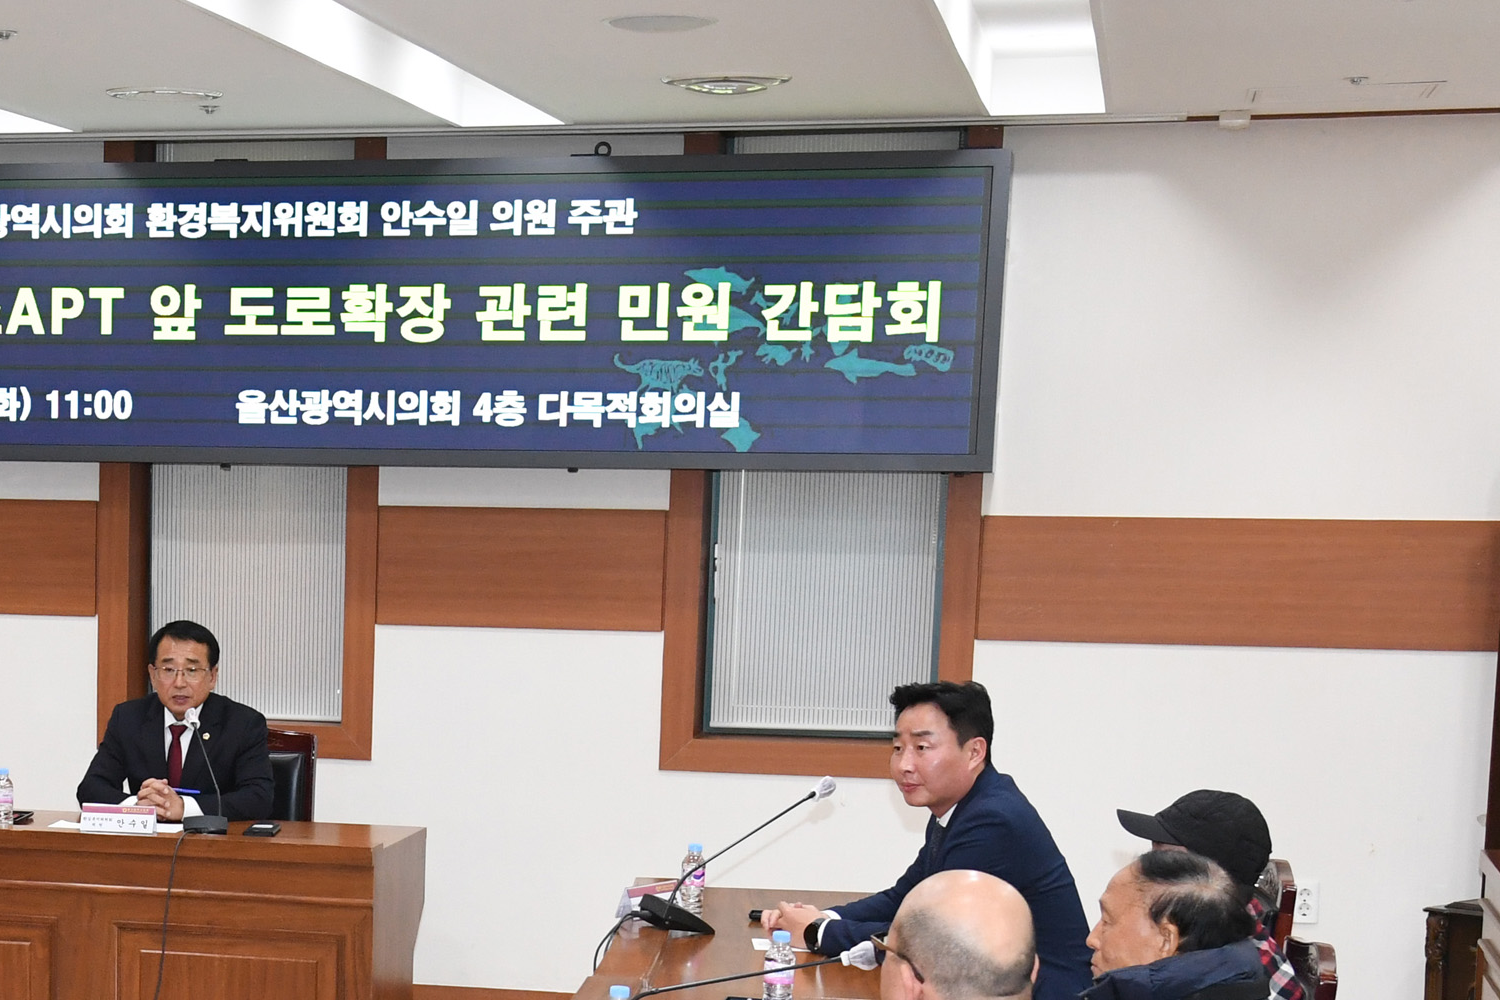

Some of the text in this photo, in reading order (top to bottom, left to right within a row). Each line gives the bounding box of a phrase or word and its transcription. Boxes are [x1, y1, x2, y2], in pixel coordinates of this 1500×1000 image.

[145, 200, 369, 239] 환경복지위원회
[380, 199, 479, 237] 안수일
[489, 198, 557, 236] 의원
[567, 197, 639, 236] 주관
[150, 283, 202, 341] 앞
[224, 283, 452, 343] 도로확장
[475, 282, 588, 342] 관련
[618, 281, 732, 342] 민원
[761, 280, 942, 343] 간담회
[45, 388, 133, 420] 11:00
[235, 388, 741, 429] 울산광역시의회 4층 다목적회의실
